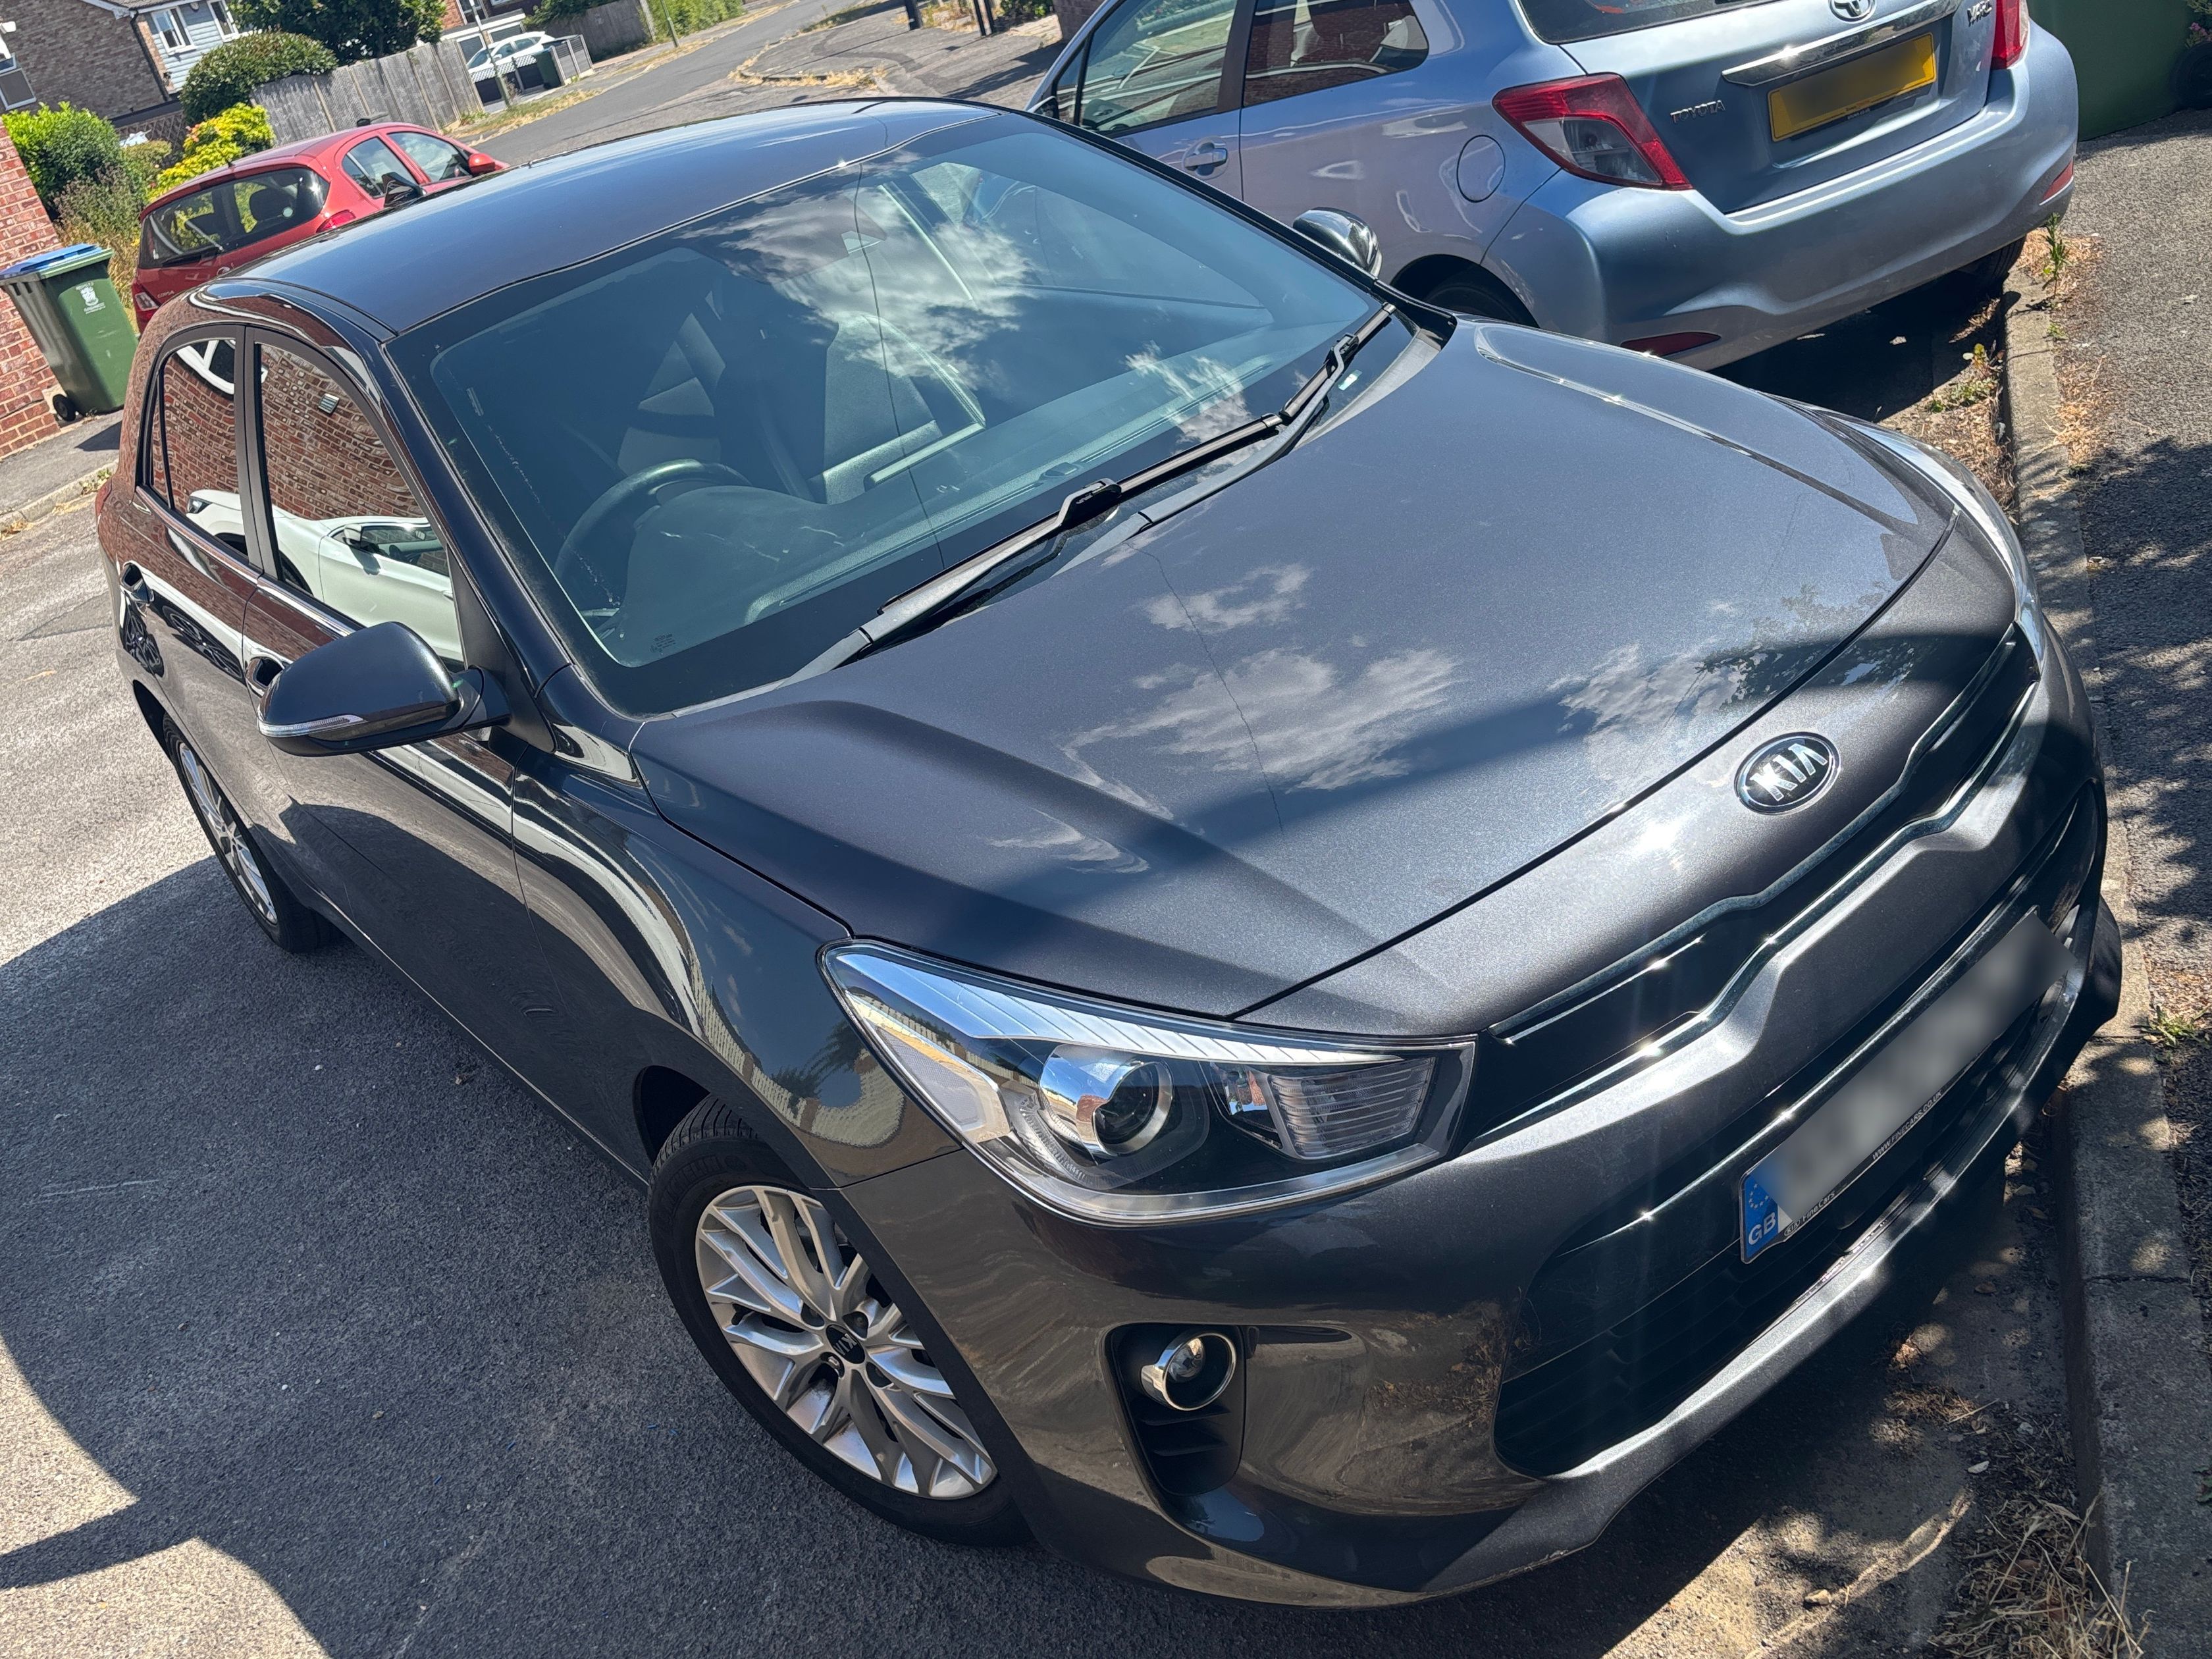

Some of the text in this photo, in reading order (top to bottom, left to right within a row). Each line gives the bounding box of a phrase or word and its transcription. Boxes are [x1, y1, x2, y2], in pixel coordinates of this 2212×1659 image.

[1670, 99, 1725, 123] TOYOTA
[1750, 743, 1828, 801] KIA
[1803, 1205, 1819, 1222] Fine
[1818, 1191, 1835, 1208] Cars
[1749, 1212, 1776, 1245] GB
[833, 1333, 857, 1356] KIA
